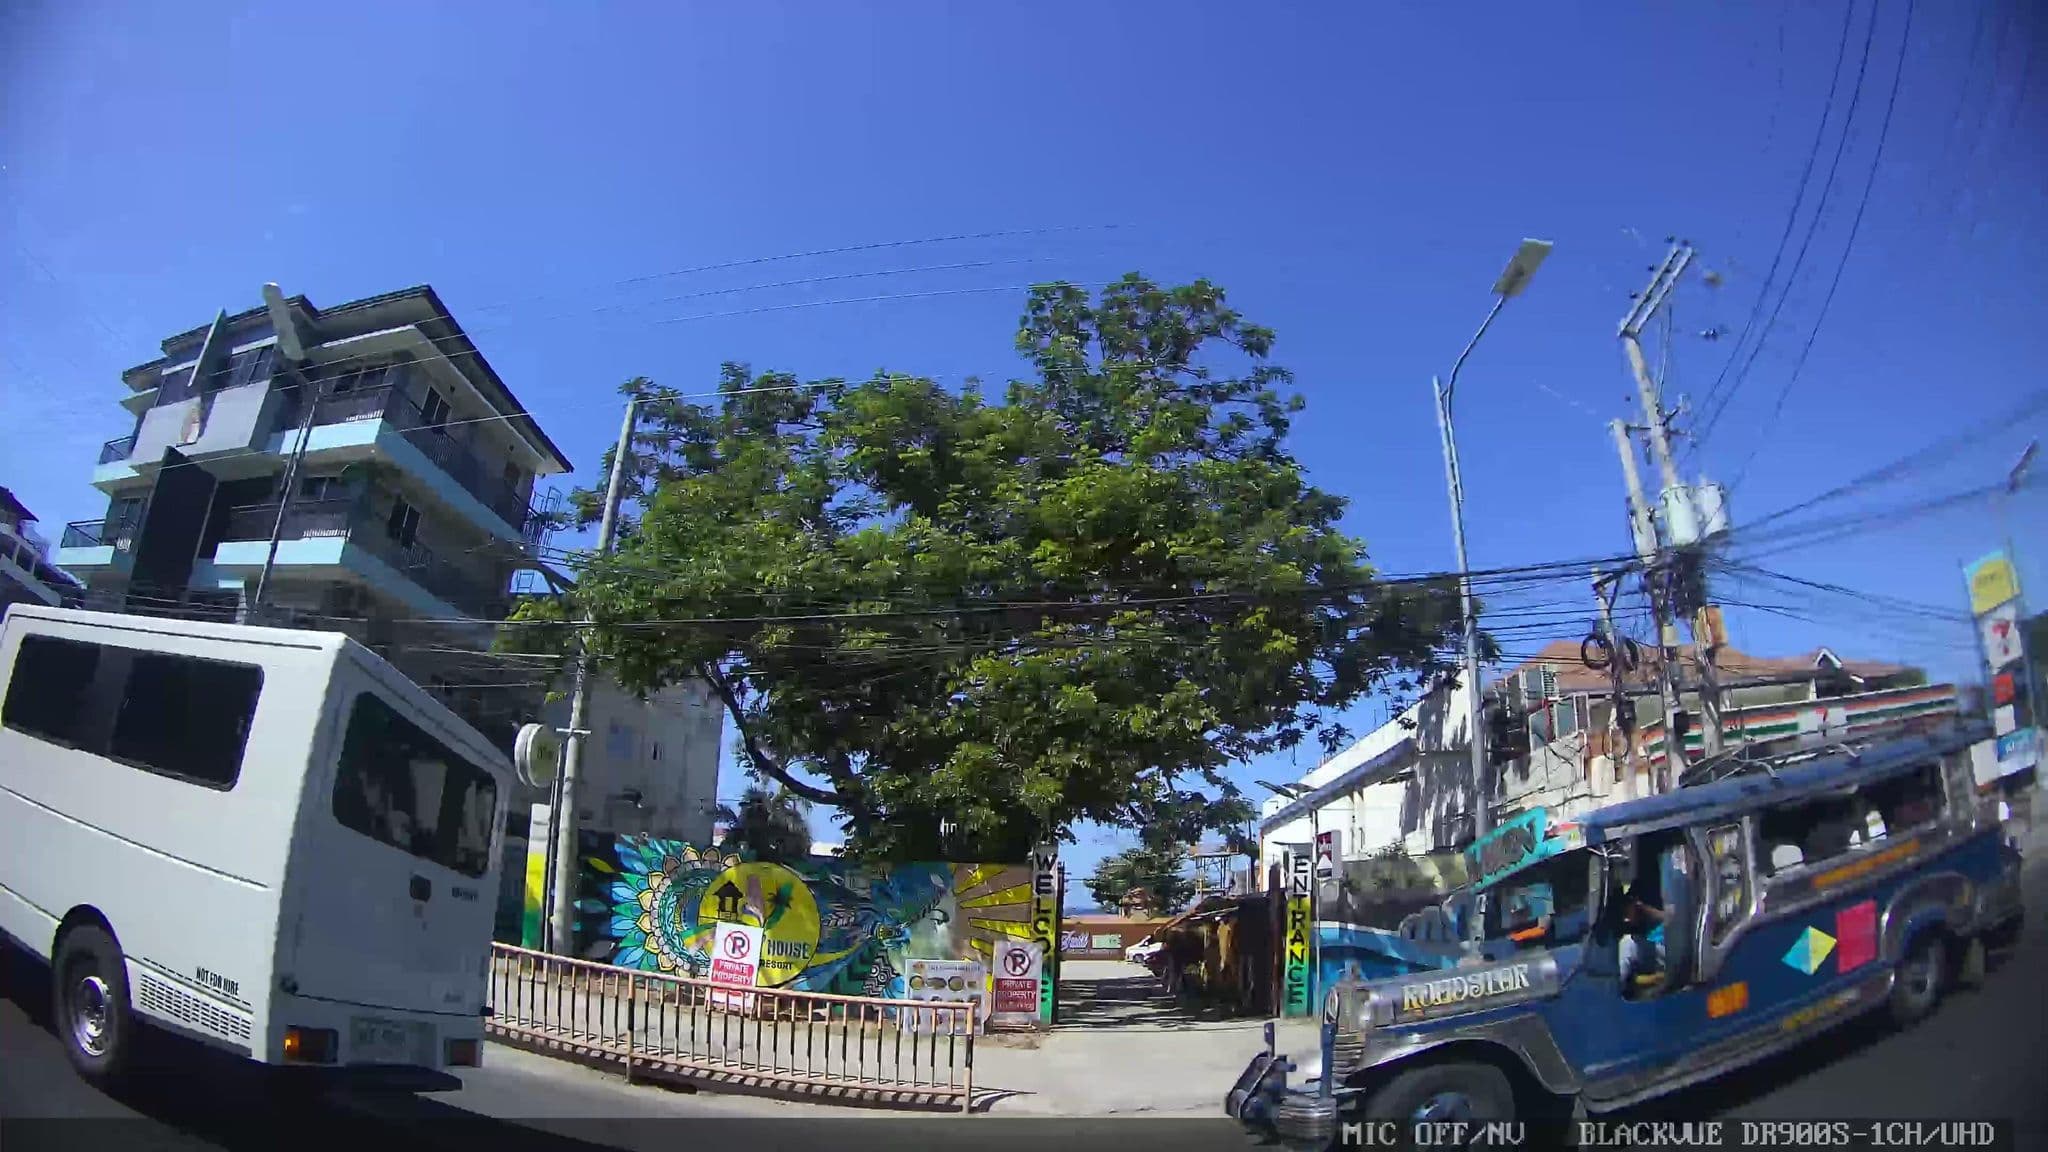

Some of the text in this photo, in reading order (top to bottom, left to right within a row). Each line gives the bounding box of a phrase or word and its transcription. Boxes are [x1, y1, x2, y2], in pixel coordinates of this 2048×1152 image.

[1288, 855, 1309, 1005] ENTRANCE
[767, 940, 811, 960] HOUSE
[719, 962, 749, 975] PRIVATE
[758, 959, 793, 972] RESORT
[196, 966, 239, 995] NOT FOR HIRE
[713, 971, 752, 985] PROPERTY
[1001, 980, 1032, 989] PRIVATE
[997, 990, 1036, 1000] PROPERTY
